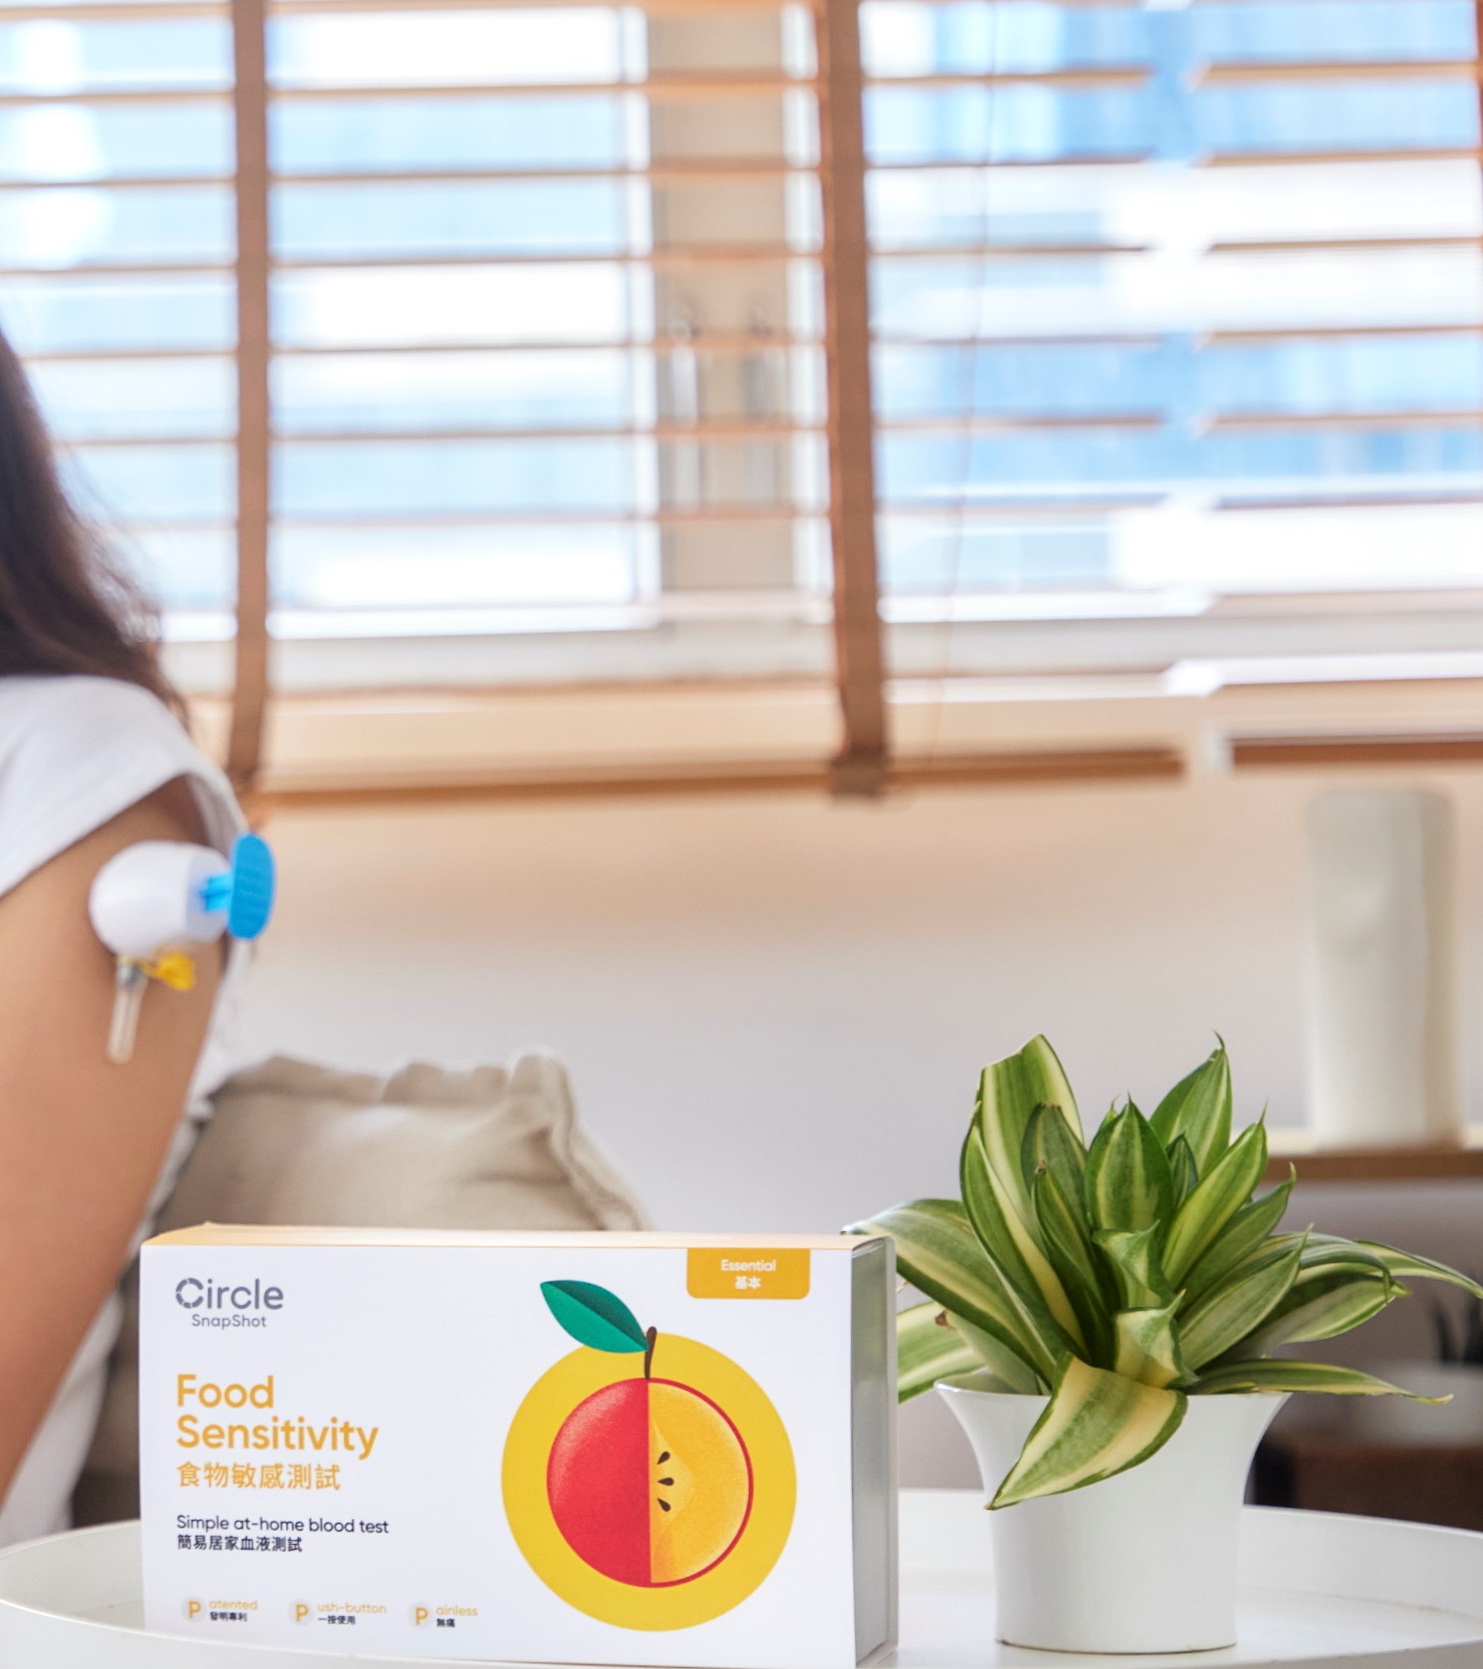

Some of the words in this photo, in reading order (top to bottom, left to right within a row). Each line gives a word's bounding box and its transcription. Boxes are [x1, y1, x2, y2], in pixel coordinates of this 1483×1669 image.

[721, 1259, 776, 1272] Essential
[735, 1276, 761, 1290] 基本
[175, 1277, 284, 1310] Circle
[191, 1314, 267, 1330] SnapShot
[177, 1374, 274, 1409] Food
[177, 1414, 379, 1460] Sensitivity
[177, 1461, 341, 1490] 食物敏感測試
[177, 1515, 229, 1533] Simple
[233, 1516, 304, 1532] at-home
[308, 1517, 355, 1533] blood
[359, 1520, 389, 1534] test
[177, 1534, 304, 1552] 簡易居家血液測試
[209, 1611, 248, 1623] 發明專利
[317, 1614, 356, 1626] 一按使用
[436, 1617, 456, 1629] 無痛
